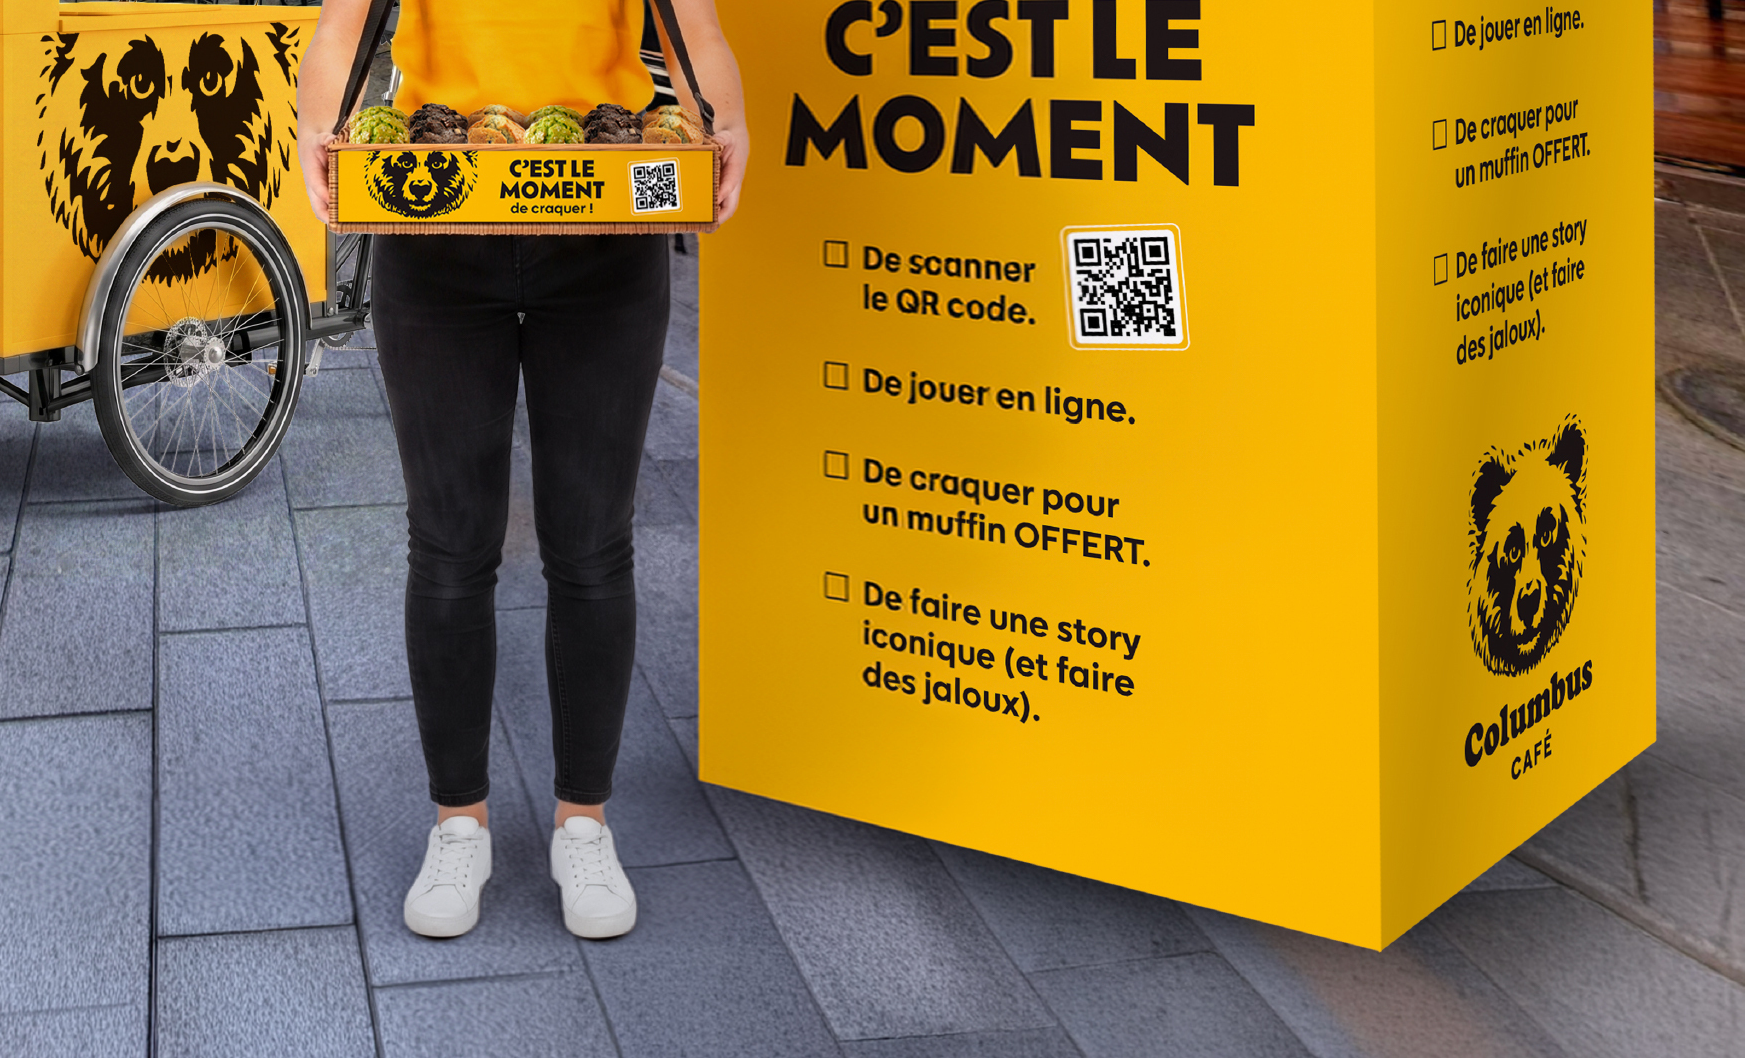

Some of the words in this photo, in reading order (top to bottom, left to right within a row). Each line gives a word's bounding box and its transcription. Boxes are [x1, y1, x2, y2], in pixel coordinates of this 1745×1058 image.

[1454, 19, 1477, 48] De
[1479, 15, 1521, 51] jouer
[1523, 16, 1543, 37] en
[1545, 6, 1585, 39] ligne.
[784, 92, 1256, 187] MOMENT
[1455, 117, 1477, 146] De
[1480, 107, 1543, 140] craquer
[1545, 98, 1579, 132] pour
[509, 159, 567, 178] C'EST
[570, 159, 595, 178] LE
[1455, 163, 1476, 189] un
[1479, 146, 1530, 184] muffin
[1532, 131, 1592, 169] OFFERT.
[499, 180, 606, 199] MOMENT
[510, 202, 528, 214] de
[530, 204, 587, 217] craquer
[588, 202, 594, 214] !
[862, 245, 902, 274] De
[908, 252, 1037, 284] scanner
[1456, 250, 1478, 279] De
[1481, 236, 1518, 270] faire
[1521, 230, 1549, 259] une
[1551, 218, 1588, 249] story
[862, 283, 889, 312] le
[896, 289, 940, 319] QR
[947, 292, 1037, 326] code.
[1456, 276, 1525, 322] iconique
[1527, 268, 1549, 303] (et
[1551, 256, 1586, 289] faire
[1456, 335, 1486, 366] des
[1488, 308, 1546, 360] jaloux).
[862, 367, 903, 397] De
[908, 372, 990, 408] jouer
[996, 383, 1036, 412] en
[1044, 385, 1136, 425] ligne.
[862, 457, 903, 487] De
[909, 468, 1035, 507] craquer
[1041, 488, 1120, 519] pour
[862, 499, 899, 528] un
[907, 508, 1007, 545] muffin
[1013, 521, 1152, 568] OFFERT.
[862, 580, 903, 611] De
[909, 587, 982, 626] faire
[989, 605, 1049, 638] une
[1056, 617, 1142, 660] story
[862, 619, 996, 670] iconique
[1004, 645, 1048, 682] (et
[1056, 655, 1135, 698] faire
[861, 661, 916, 696] des
[921, 670, 1041, 724] jaloux).
[1464, 659, 1594, 768] Columbus
[1510, 728, 1553, 781] CAFÉ
